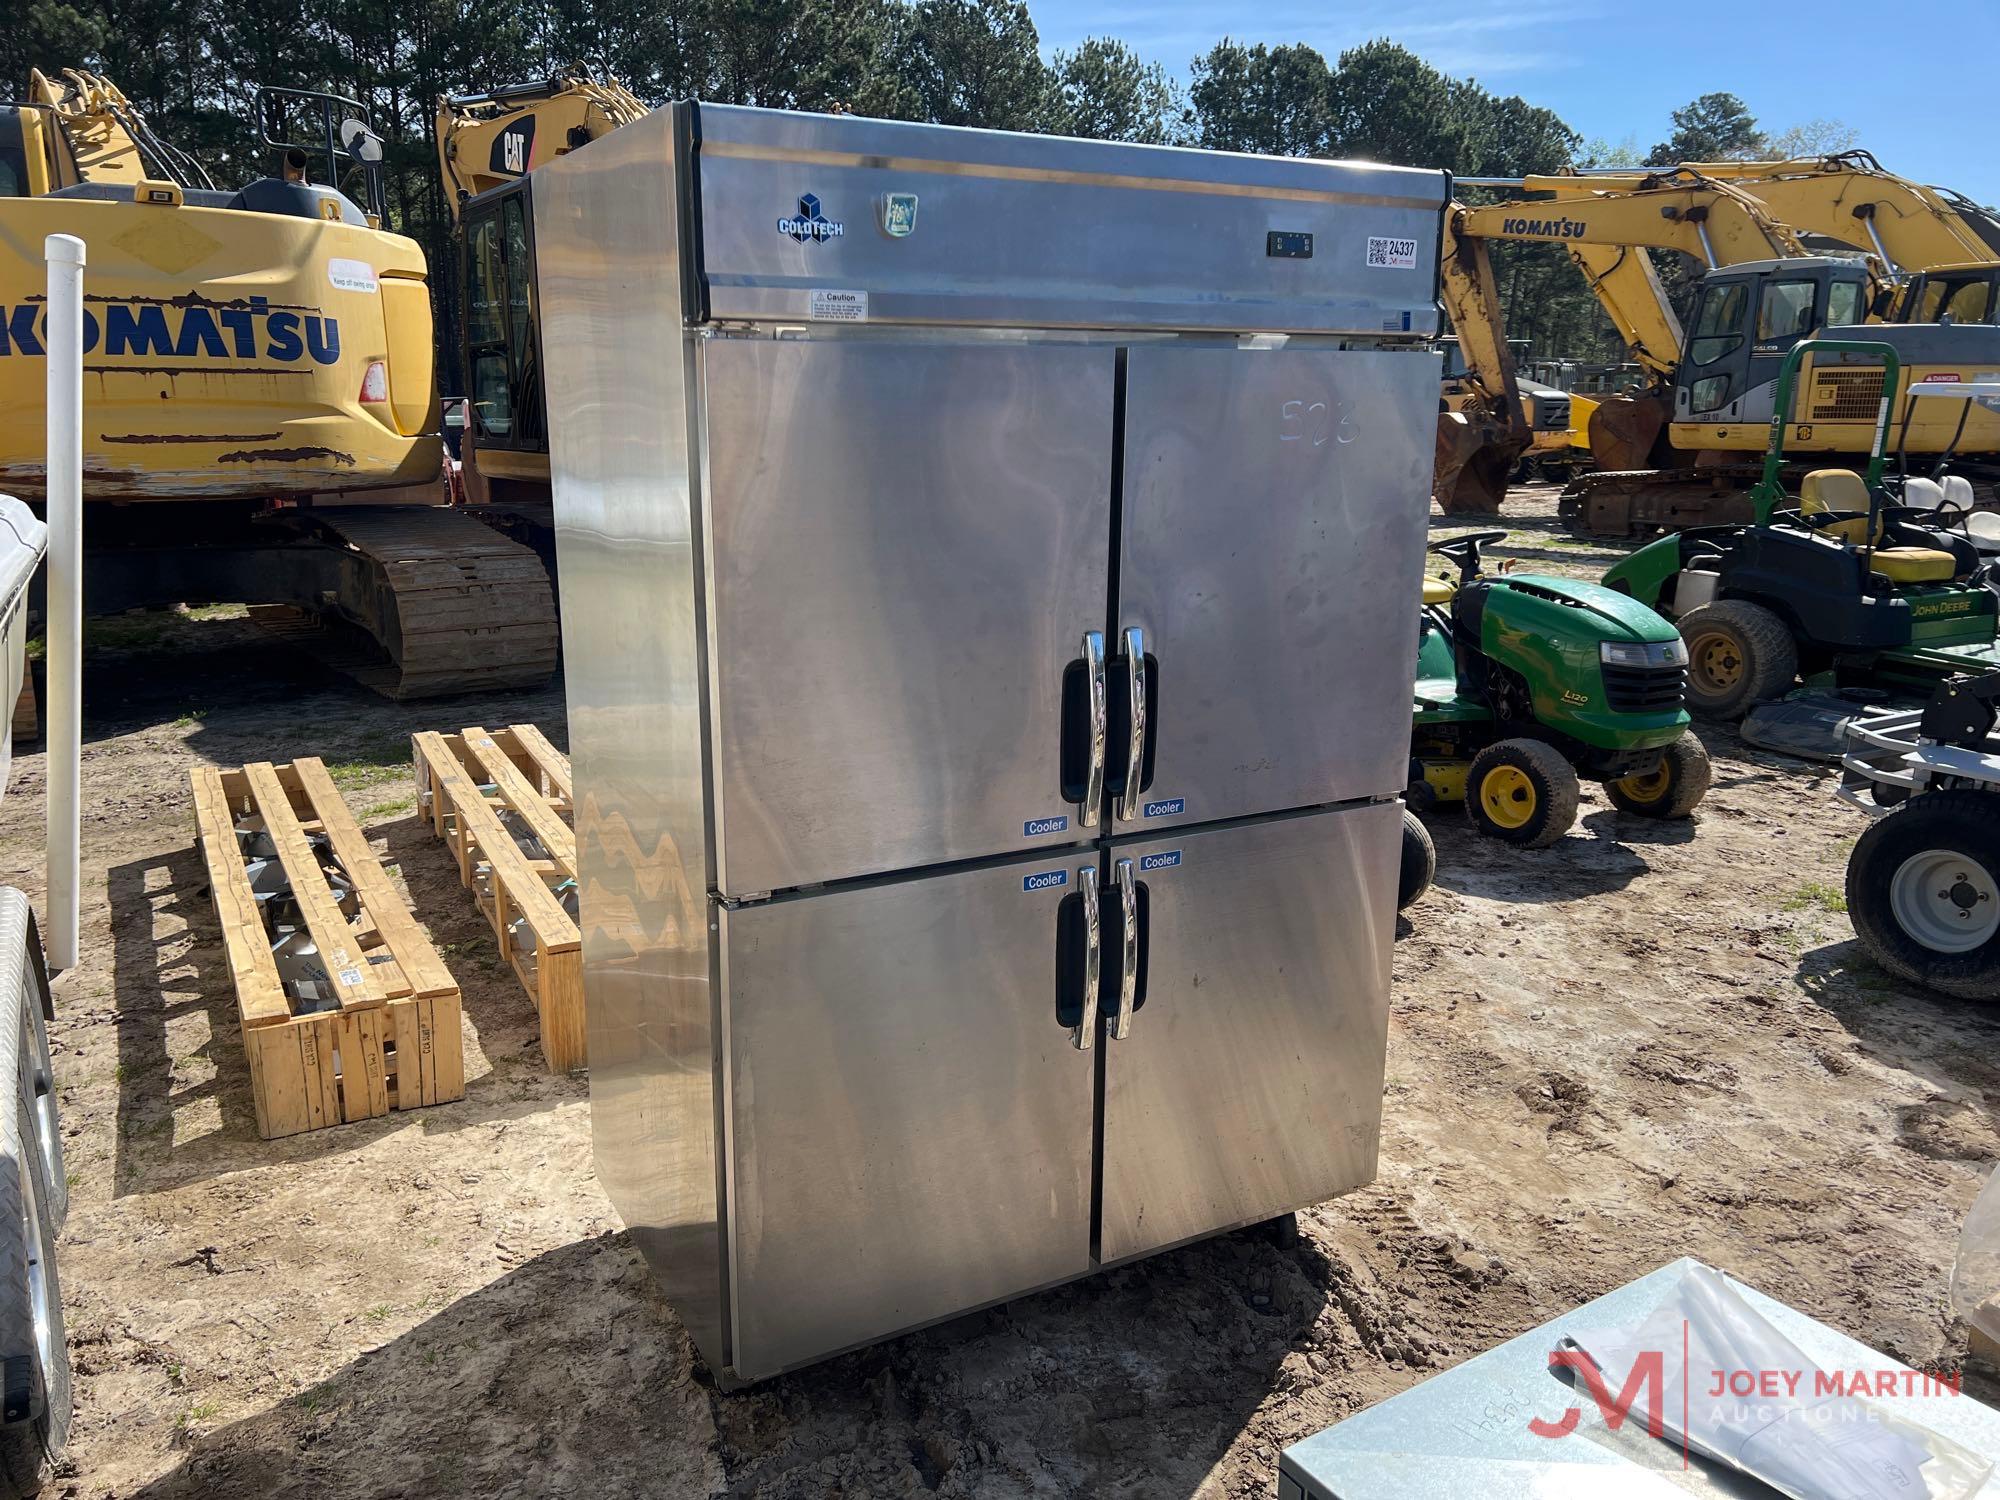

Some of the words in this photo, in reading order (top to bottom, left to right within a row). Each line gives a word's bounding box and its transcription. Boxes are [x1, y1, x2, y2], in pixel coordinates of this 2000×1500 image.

[504, 131, 525, 173] CAT
[778, 219, 844, 236] COLDTECH
[1503, 217, 1586, 238] KOMATSU
[1389, 240, 1415, 256] 24337
[826, 292, 856, 301] Caution
[1564, 690, 1588, 703] L120
[1148, 802, 1181, 816] Cooler
[1029, 820, 1064, 834] Cooler
[1145, 854, 1177, 869] Cooler
[1028, 874, 1063, 889] Cooler
